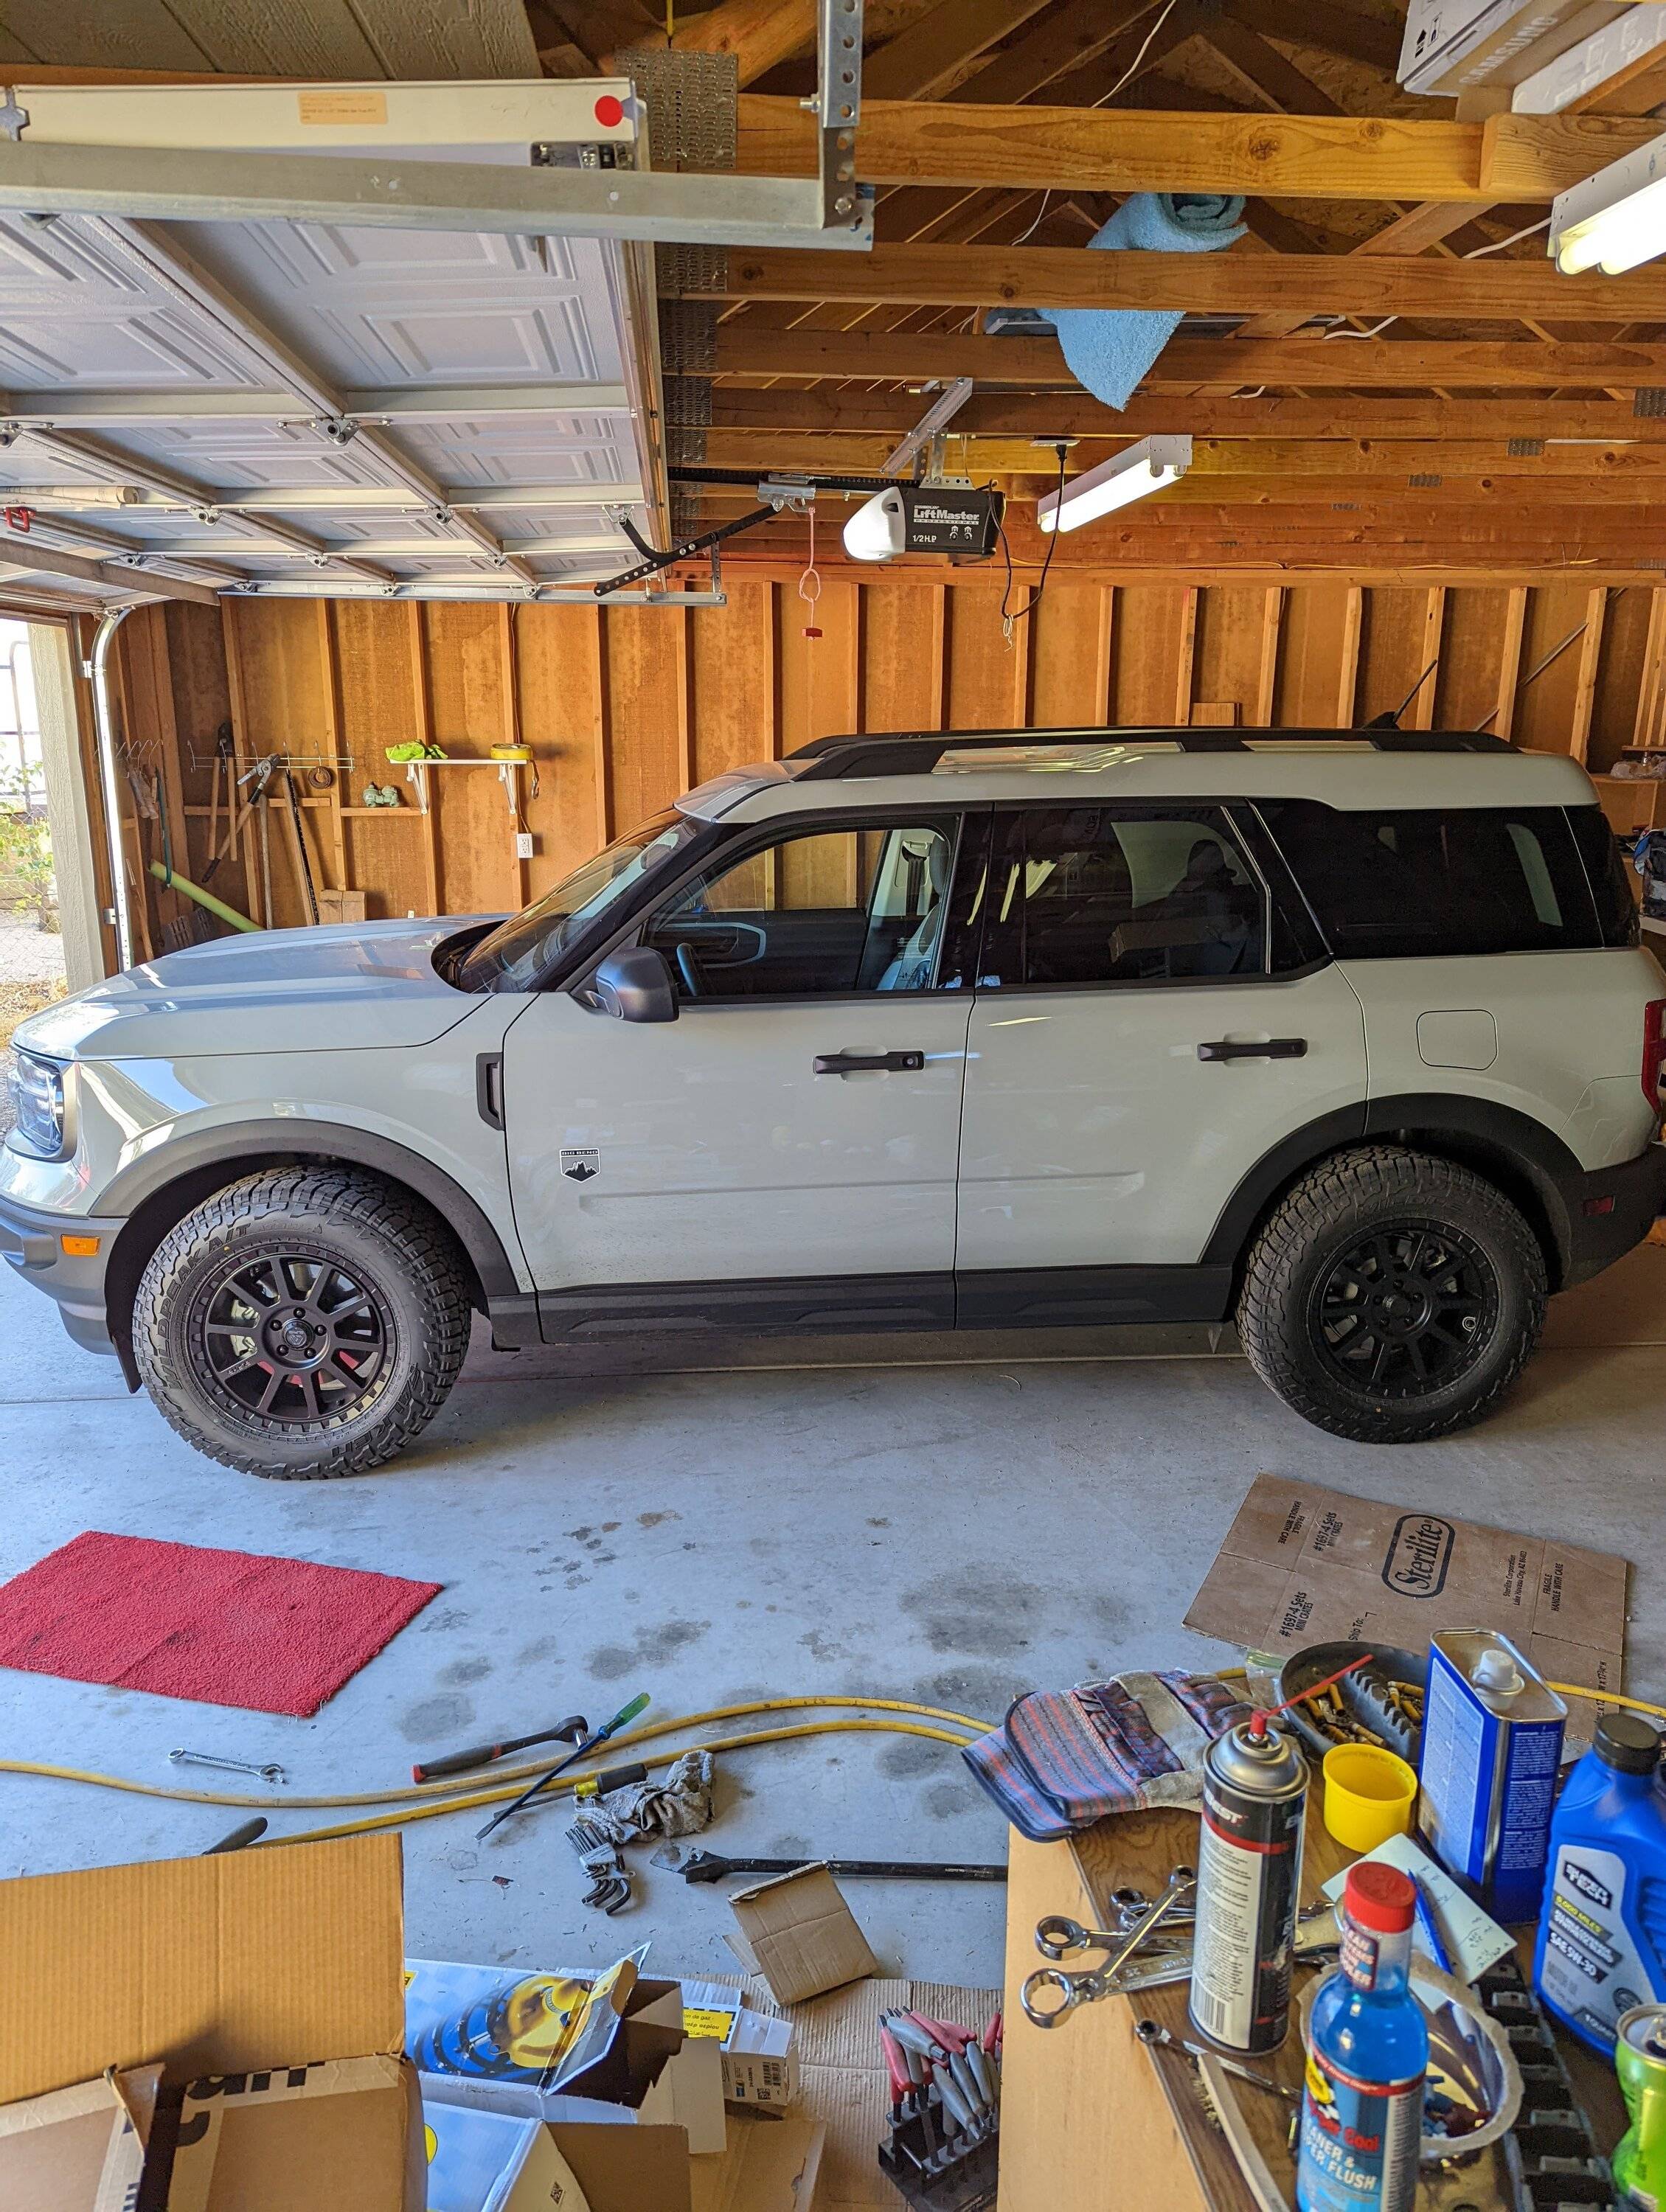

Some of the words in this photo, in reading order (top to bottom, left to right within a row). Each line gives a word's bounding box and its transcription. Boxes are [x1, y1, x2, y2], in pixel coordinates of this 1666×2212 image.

[1459, 15, 1558, 85] SAMSUNG
[914, 508, 979, 521] LiftMaster
[158, 1248, 205, 1391] WILDPEAK
[1323, 1512, 1337, 1526] Sets
[1395, 1523, 1443, 1590] Sterilite
[1554, 1562, 1563, 1576] CARE
[1542, 1573, 1552, 1595] FRAGILE
[1553, 1576, 1563, 1590] WITH
[1291, 1591, 1307, 1607] Sets
[1551, 1590, 1561, 1612] HANDLE
[1299, 1601, 1313, 1619] CRATES
[1348, 1628, 1361, 1641] Ship
[1344, 2126, 1380, 2152] Cool
[1344, 2156, 1356, 2169] &
[1327, 2160, 1377, 2191] FLUSH
